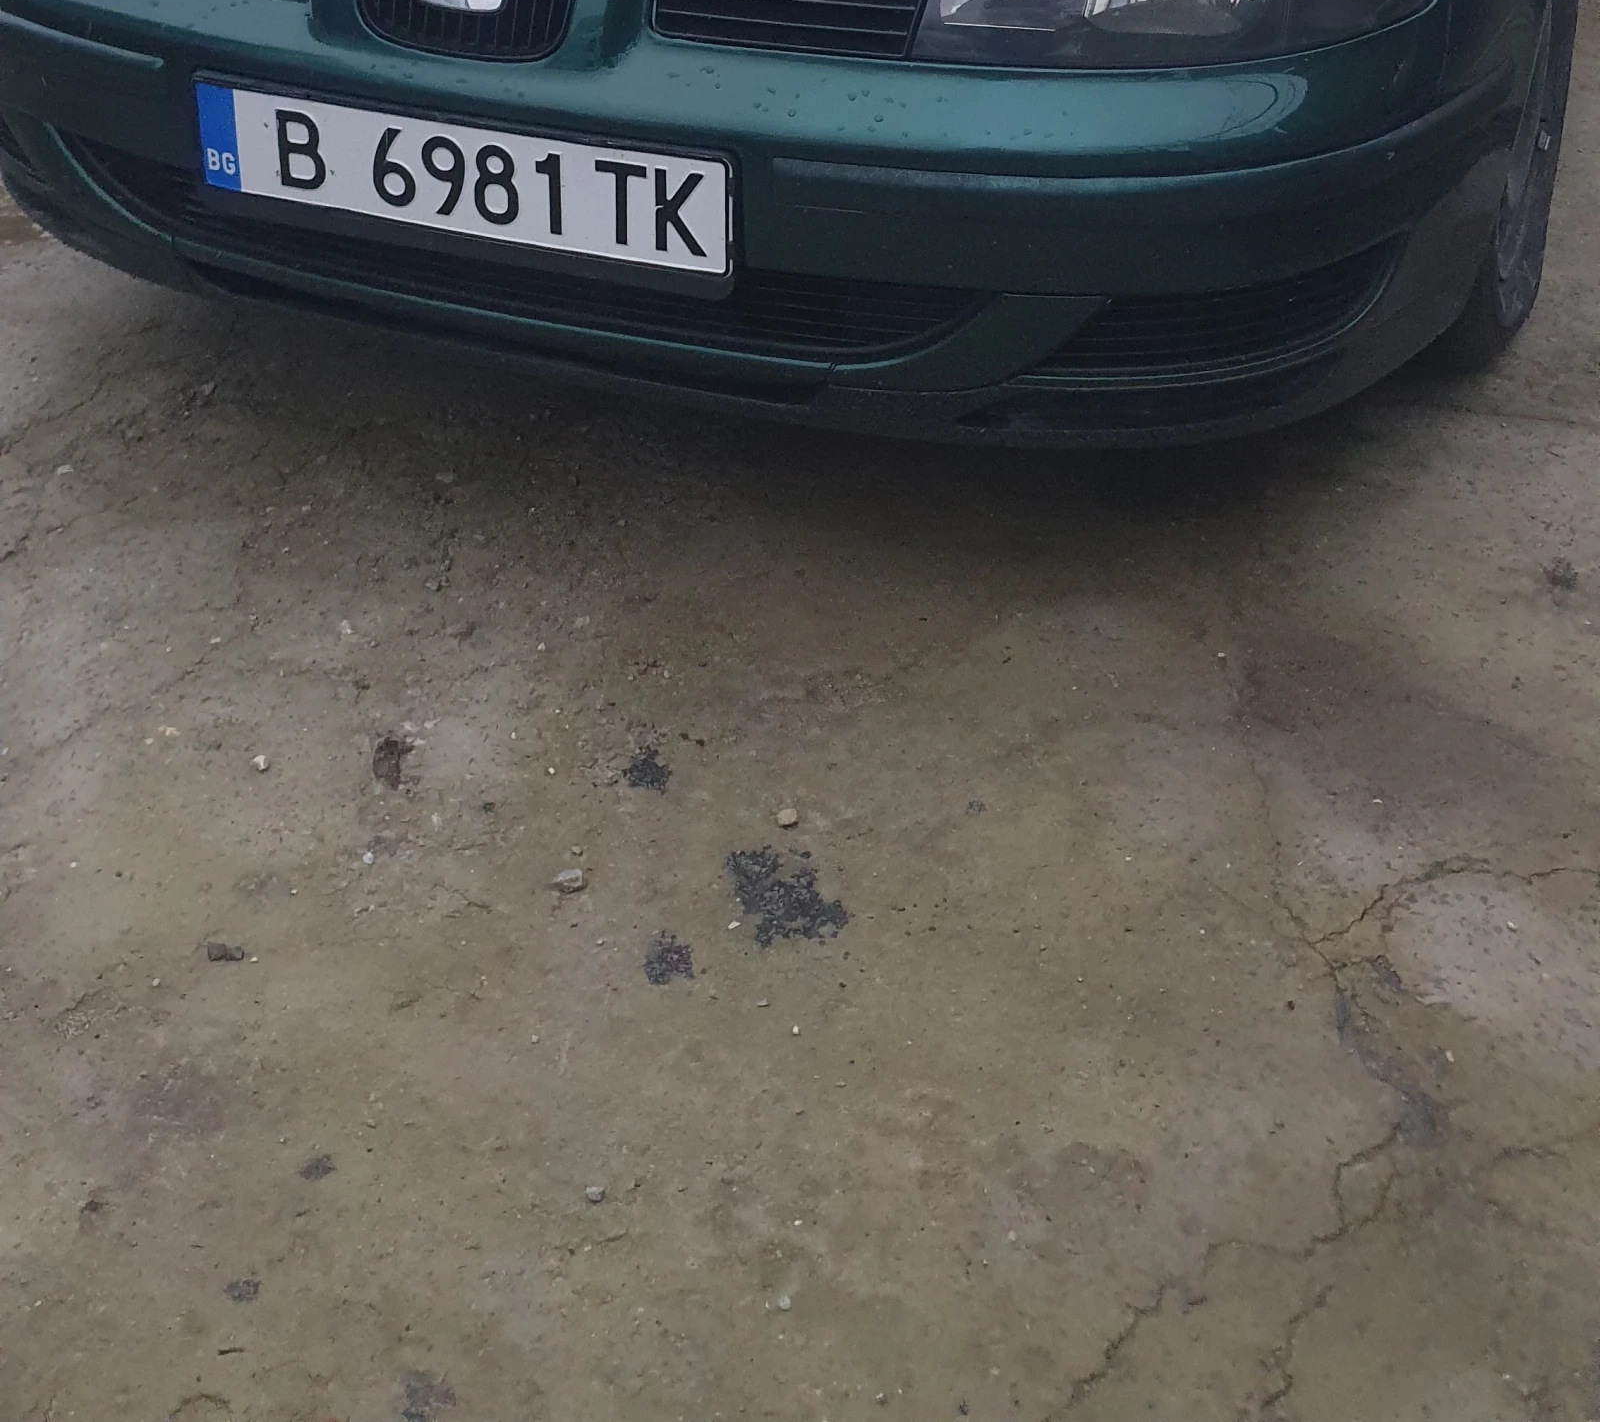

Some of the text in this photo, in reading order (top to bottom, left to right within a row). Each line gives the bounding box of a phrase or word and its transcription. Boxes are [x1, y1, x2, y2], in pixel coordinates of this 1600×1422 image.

[206, 147, 237, 175] BG
[275, 108, 708, 258] B 6981 TK
